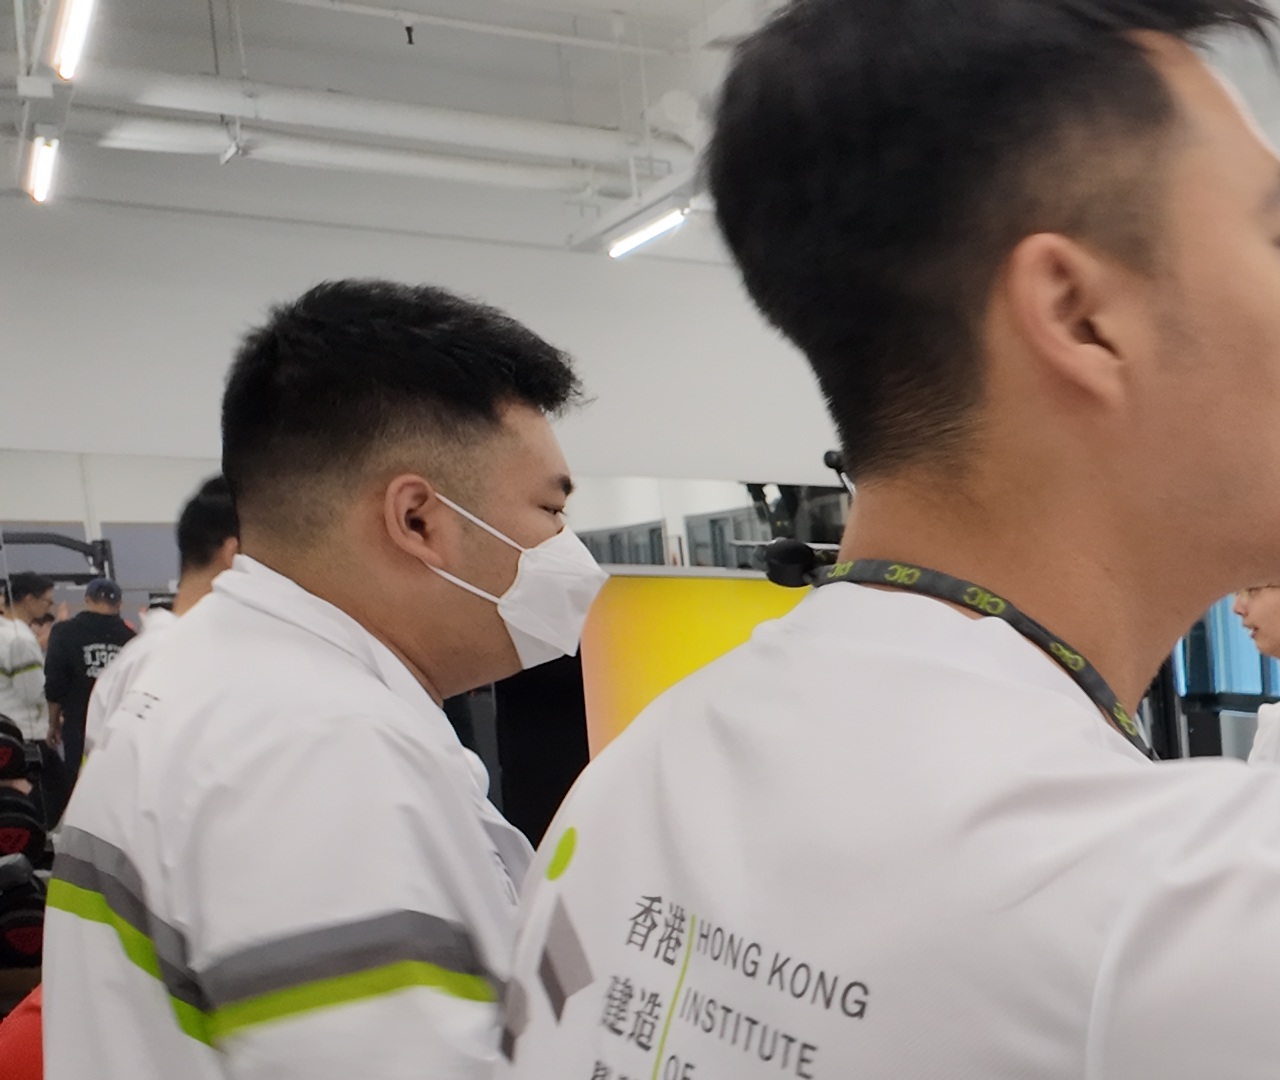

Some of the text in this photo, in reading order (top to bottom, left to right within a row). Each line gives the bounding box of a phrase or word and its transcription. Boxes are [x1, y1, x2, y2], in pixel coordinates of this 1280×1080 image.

[624, 895, 686, 966] 香港
[698, 918, 870, 1020] HONG KONG
[599, 975, 661, 1051] 建造
[679, 987, 819, 1080] INSTITUTE
